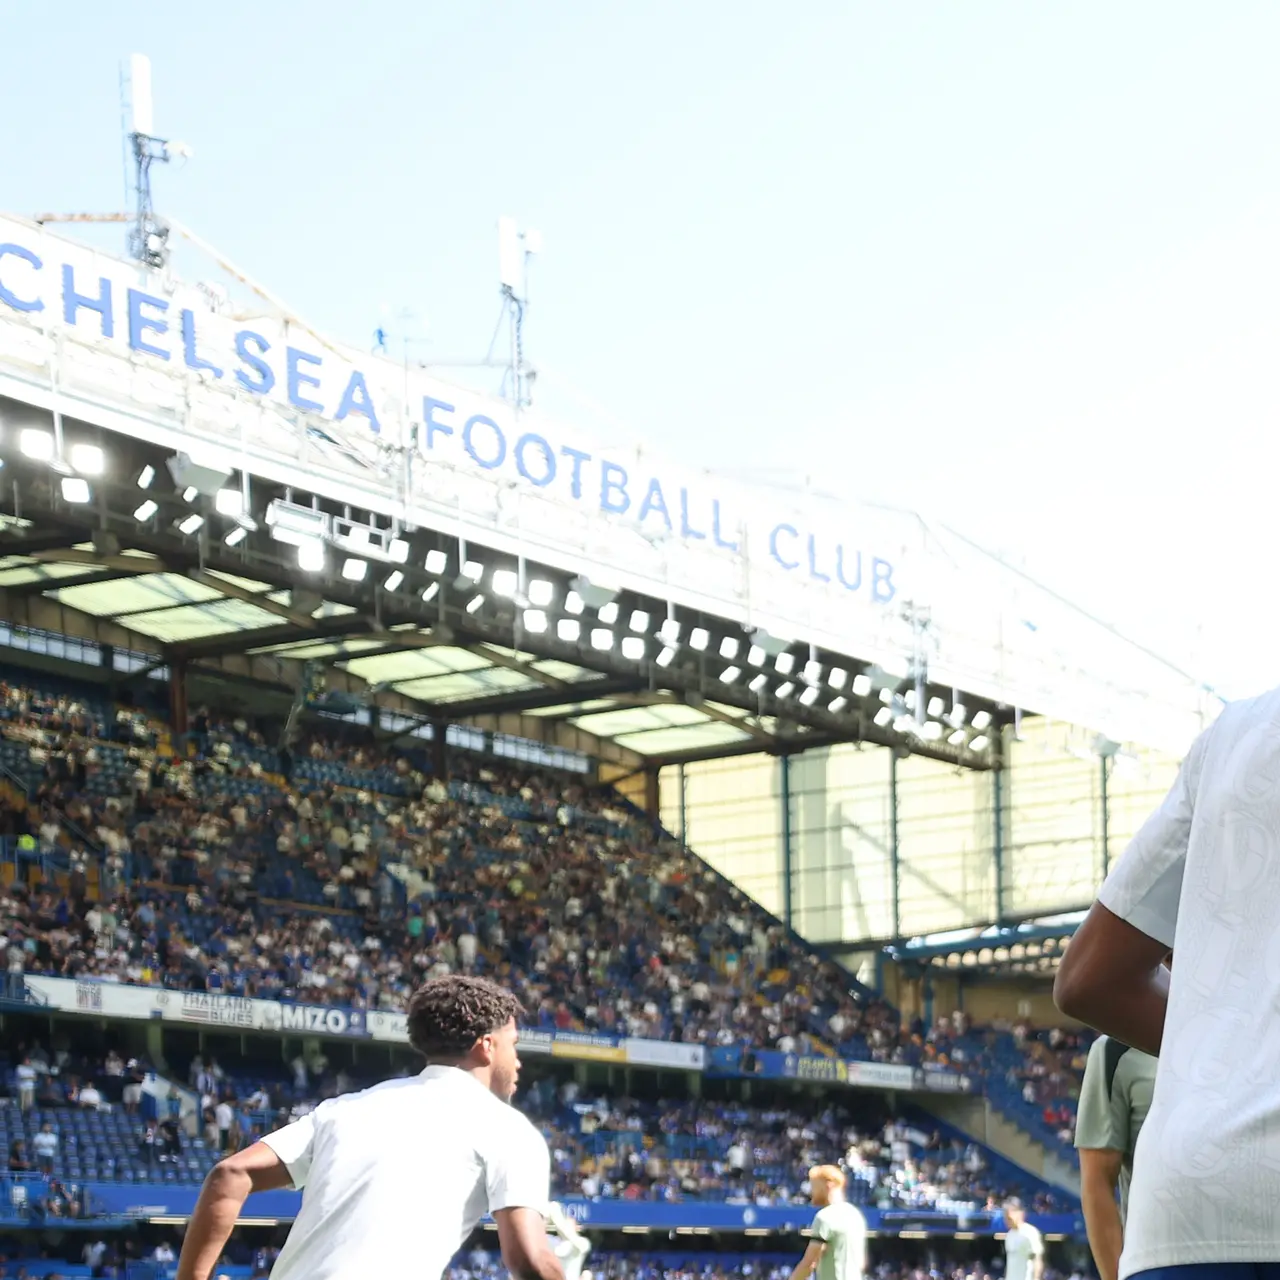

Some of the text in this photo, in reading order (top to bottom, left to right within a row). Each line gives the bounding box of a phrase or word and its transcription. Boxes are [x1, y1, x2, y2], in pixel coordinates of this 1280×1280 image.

[0, 242, 897, 604] CHELSEA FOOTBALL CLUB
[282, 1004, 347, 1034] MIZO
